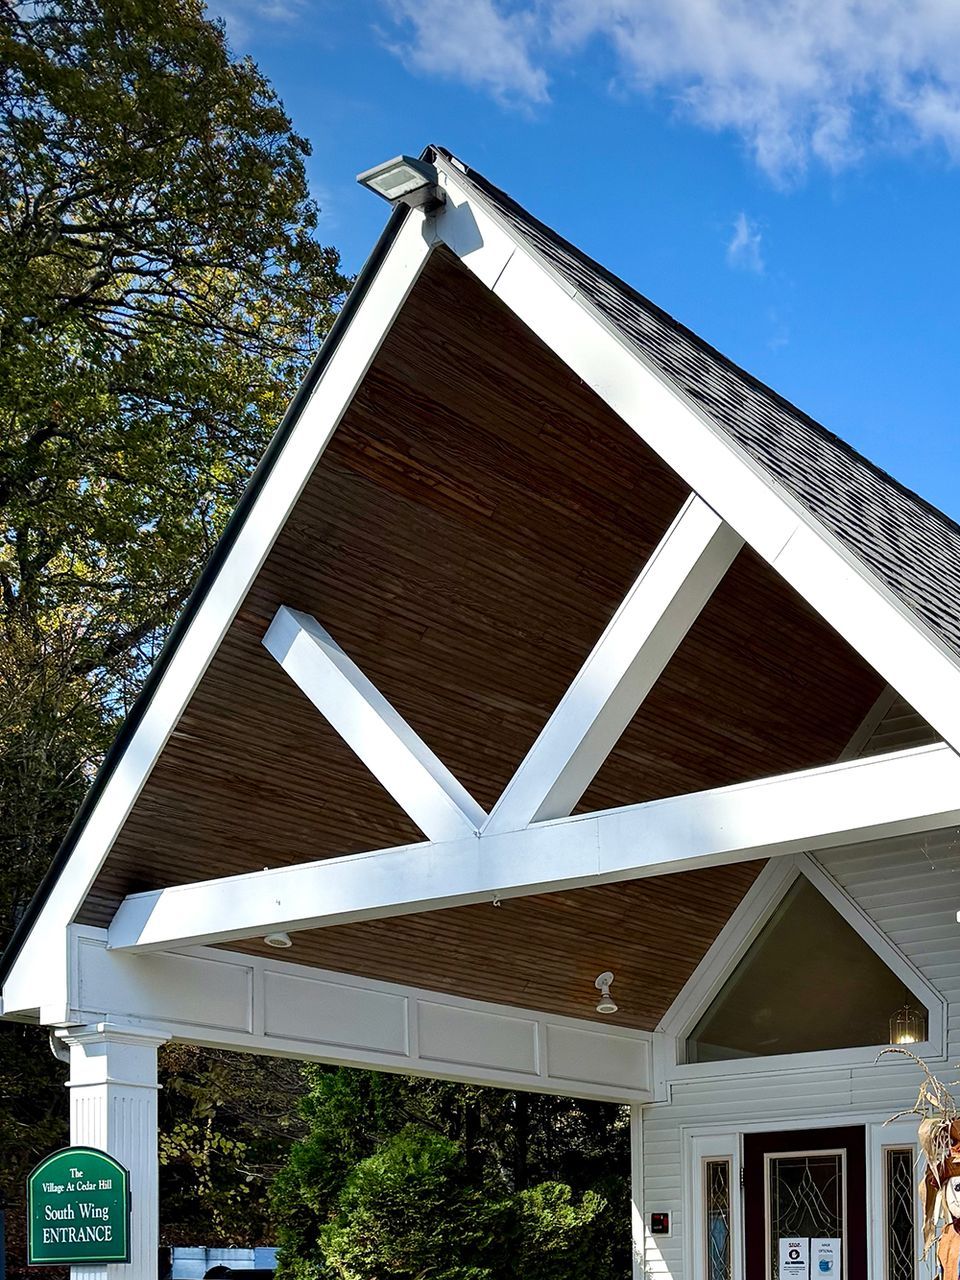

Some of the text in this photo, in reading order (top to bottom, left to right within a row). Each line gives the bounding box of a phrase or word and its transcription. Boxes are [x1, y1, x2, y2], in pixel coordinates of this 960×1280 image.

[69, 1168, 83, 1178] The
[42, 1180, 112, 1194] Village At Cedar Hill
[45, 1203, 109, 1221] South Wing
[43, 1225, 112, 1243] ENTRANCE
